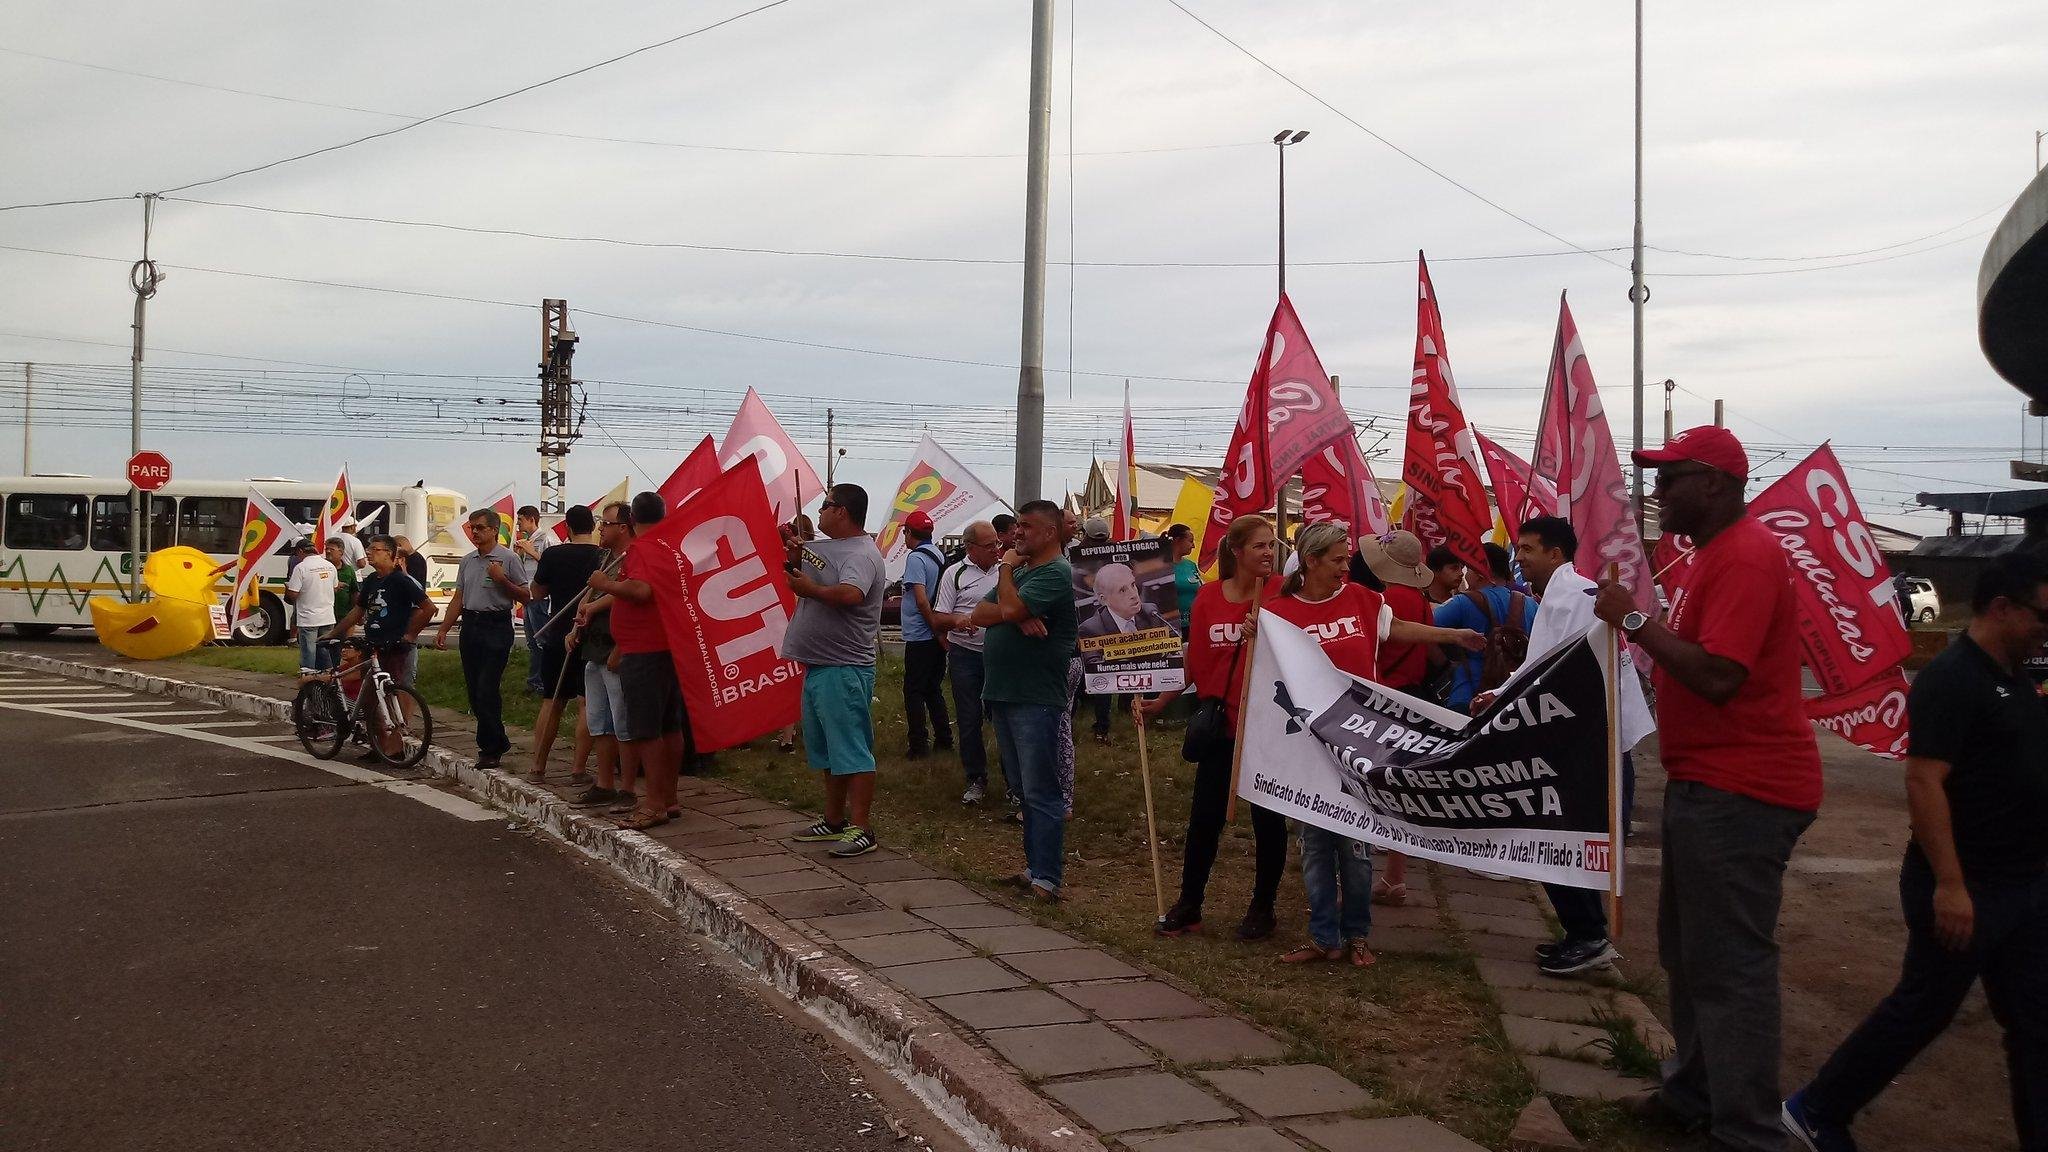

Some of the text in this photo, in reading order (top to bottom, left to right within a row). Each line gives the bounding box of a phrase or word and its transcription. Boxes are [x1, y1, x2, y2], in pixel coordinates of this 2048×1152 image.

[131, 465, 168, 477] PARE
[1081, 546, 1115, 556] DEPUTADO
[1132, 541, 1160, 550] FOGAÇA
[681, 515, 789, 667] CUT
[1084, 629, 1166, 648] Ele quer acabar com
[1209, 623, 1243, 642] CU
[686, 603, 698, 623] DOS
[694, 624, 722, 708] TRABALHADORES
[1113, 648, 1126, 656] sua
[1120, 662, 1137, 670] mais
[1137, 661, 1152, 669] vote
[1151, 660, 1169, 669] nele!
[722, 661, 802, 704] BRASIL
[1117, 675, 1150, 687] CUT
[1340, 713, 1378, 739] DA
[1384, 767, 1402, 787] A
[1402, 756, 1559, 790] REFORMA
[1253, 772, 1294, 802] Sindicato
[1294, 788, 1310, 809] dos
[1310, 793, 1357, 826] Bancários
[1356, 810, 1371, 830] do
[1498, 848, 1506, 860] a
[1507, 839, 1535, 864] luta!!
[1536, 841, 1573, 867] Filiado
[1575, 843, 1583, 868] à
[1584, 844, 1609, 871] CUT
